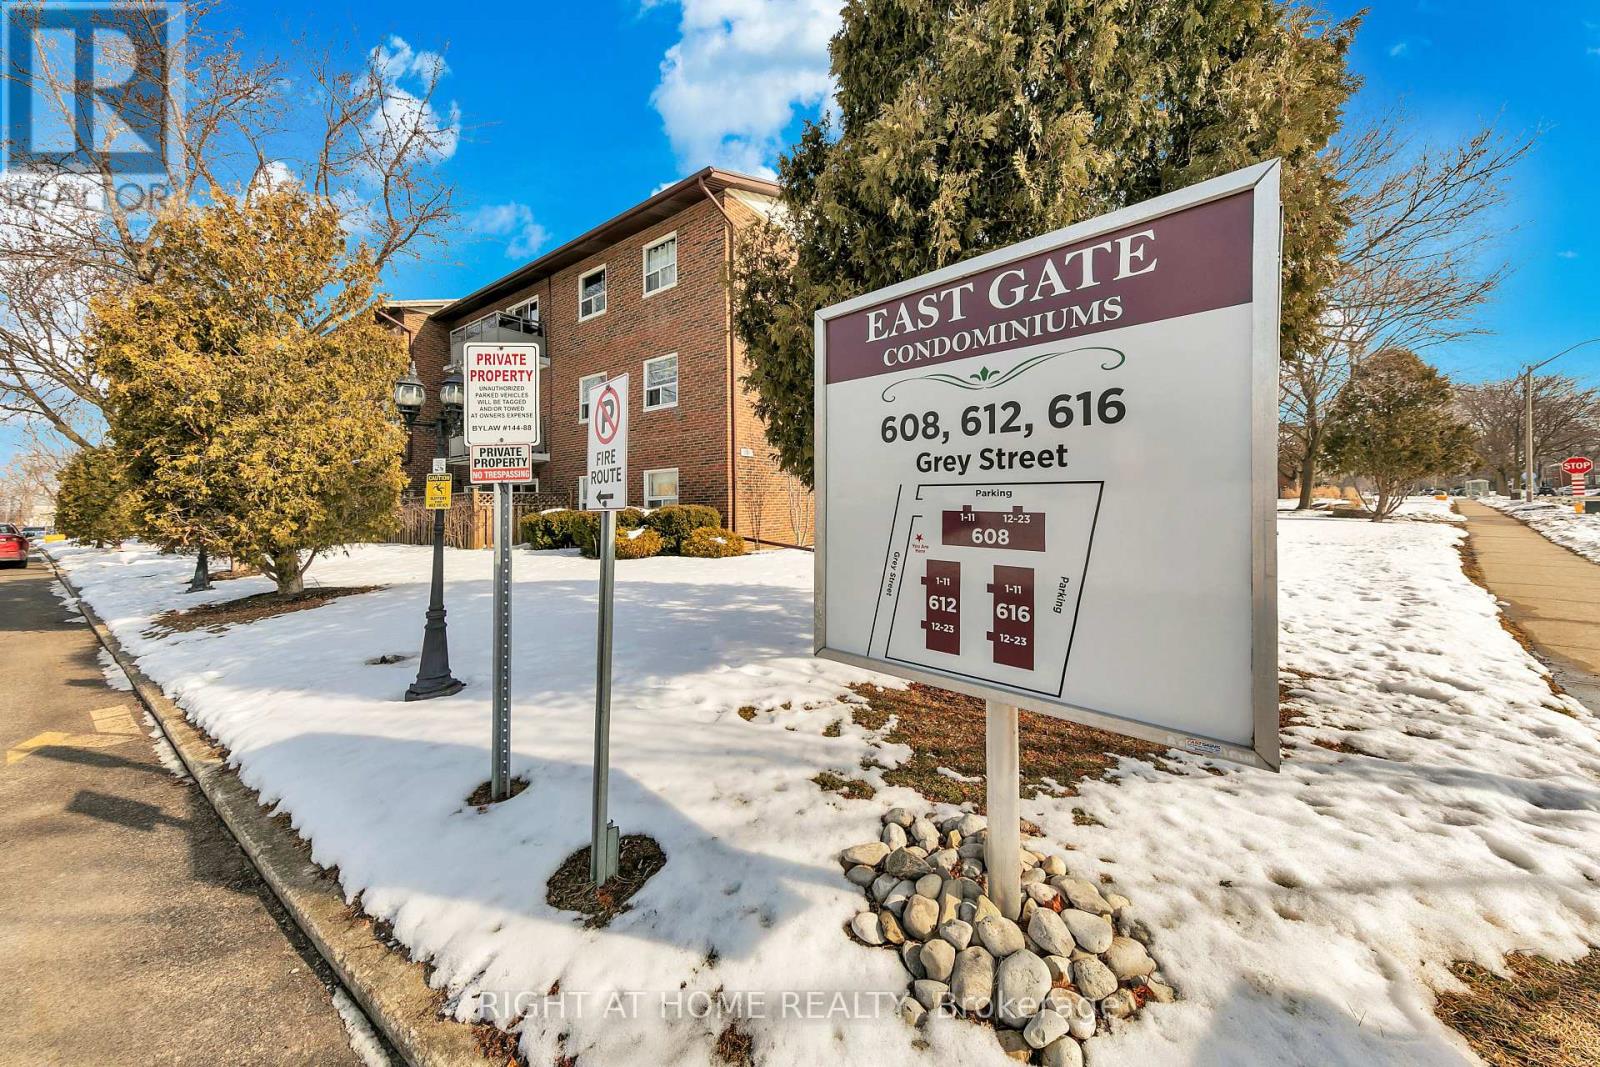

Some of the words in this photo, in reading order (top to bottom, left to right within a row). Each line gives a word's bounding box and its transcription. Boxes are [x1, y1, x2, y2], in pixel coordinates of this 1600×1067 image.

[866, 282, 974, 343] EAST
[988, 229, 1158, 310] GATE
[883, 296, 1123, 367] CONDOMINIUMS
[477, 354, 526, 366] PRIVATE
[470, 370, 533, 382] PROPERTY
[881, 410, 950, 444] 608,
[961, 400, 1033, 439] 612,
[1048, 387, 1126, 430] 616
[480, 448, 522, 457] PRIVATE
[596, 449, 616, 465] FIRE
[916, 452, 971, 475] Grey
[979, 444, 1068, 470] Street
[474, 457, 527, 468] PROPERTY
[472, 471, 482, 479] NO
[485, 470, 530, 479] TRESPASSING
[591, 467, 622, 484] ROUTE
[976, 489, 1012, 498] Parking
[960, 513, 975, 522] 1-11
[1003, 515, 1030, 523] 12-23
[972, 528, 1009, 545] 608
[890, 552, 900, 572] Grey
[886, 572, 897, 596] Street
[936, 577, 950, 586] 1-11
[1005, 585, 1021, 594] 1-11
[1053, 577, 1069, 614] Parking
[929, 596, 957, 613] 612
[996, 604, 1030, 622] 616
[931, 622, 954, 633] 12-23
[1000, 634, 1027, 646] 12-23
